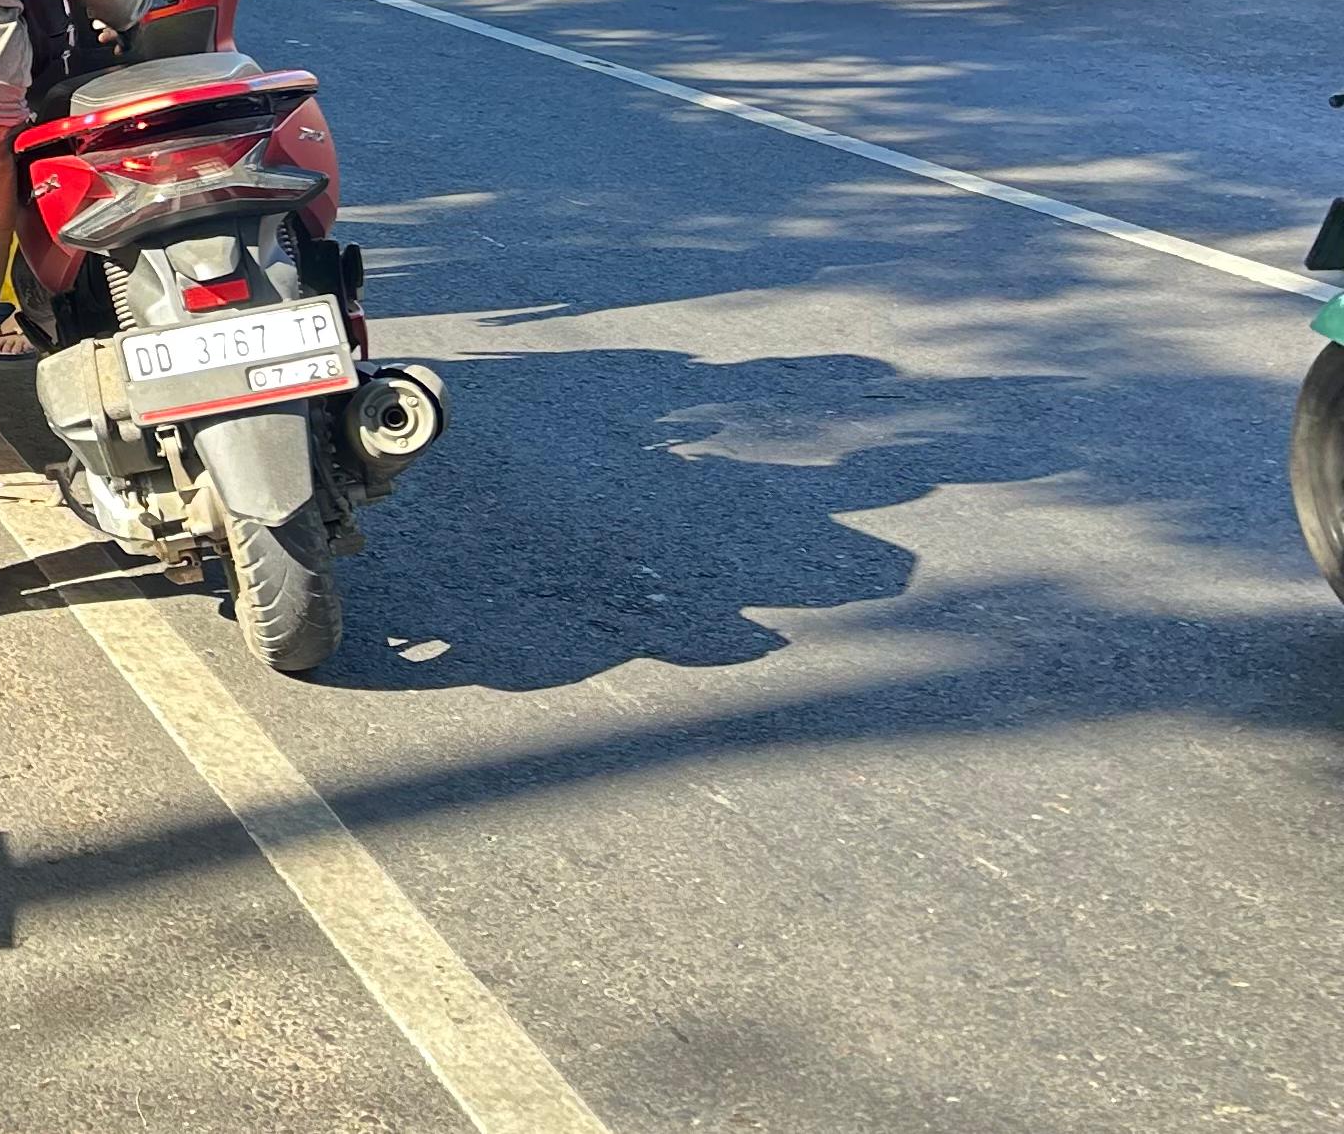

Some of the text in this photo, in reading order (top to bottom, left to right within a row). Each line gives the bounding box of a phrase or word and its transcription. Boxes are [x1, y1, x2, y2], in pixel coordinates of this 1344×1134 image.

[136, 314, 327, 376] DD 3767 TP
